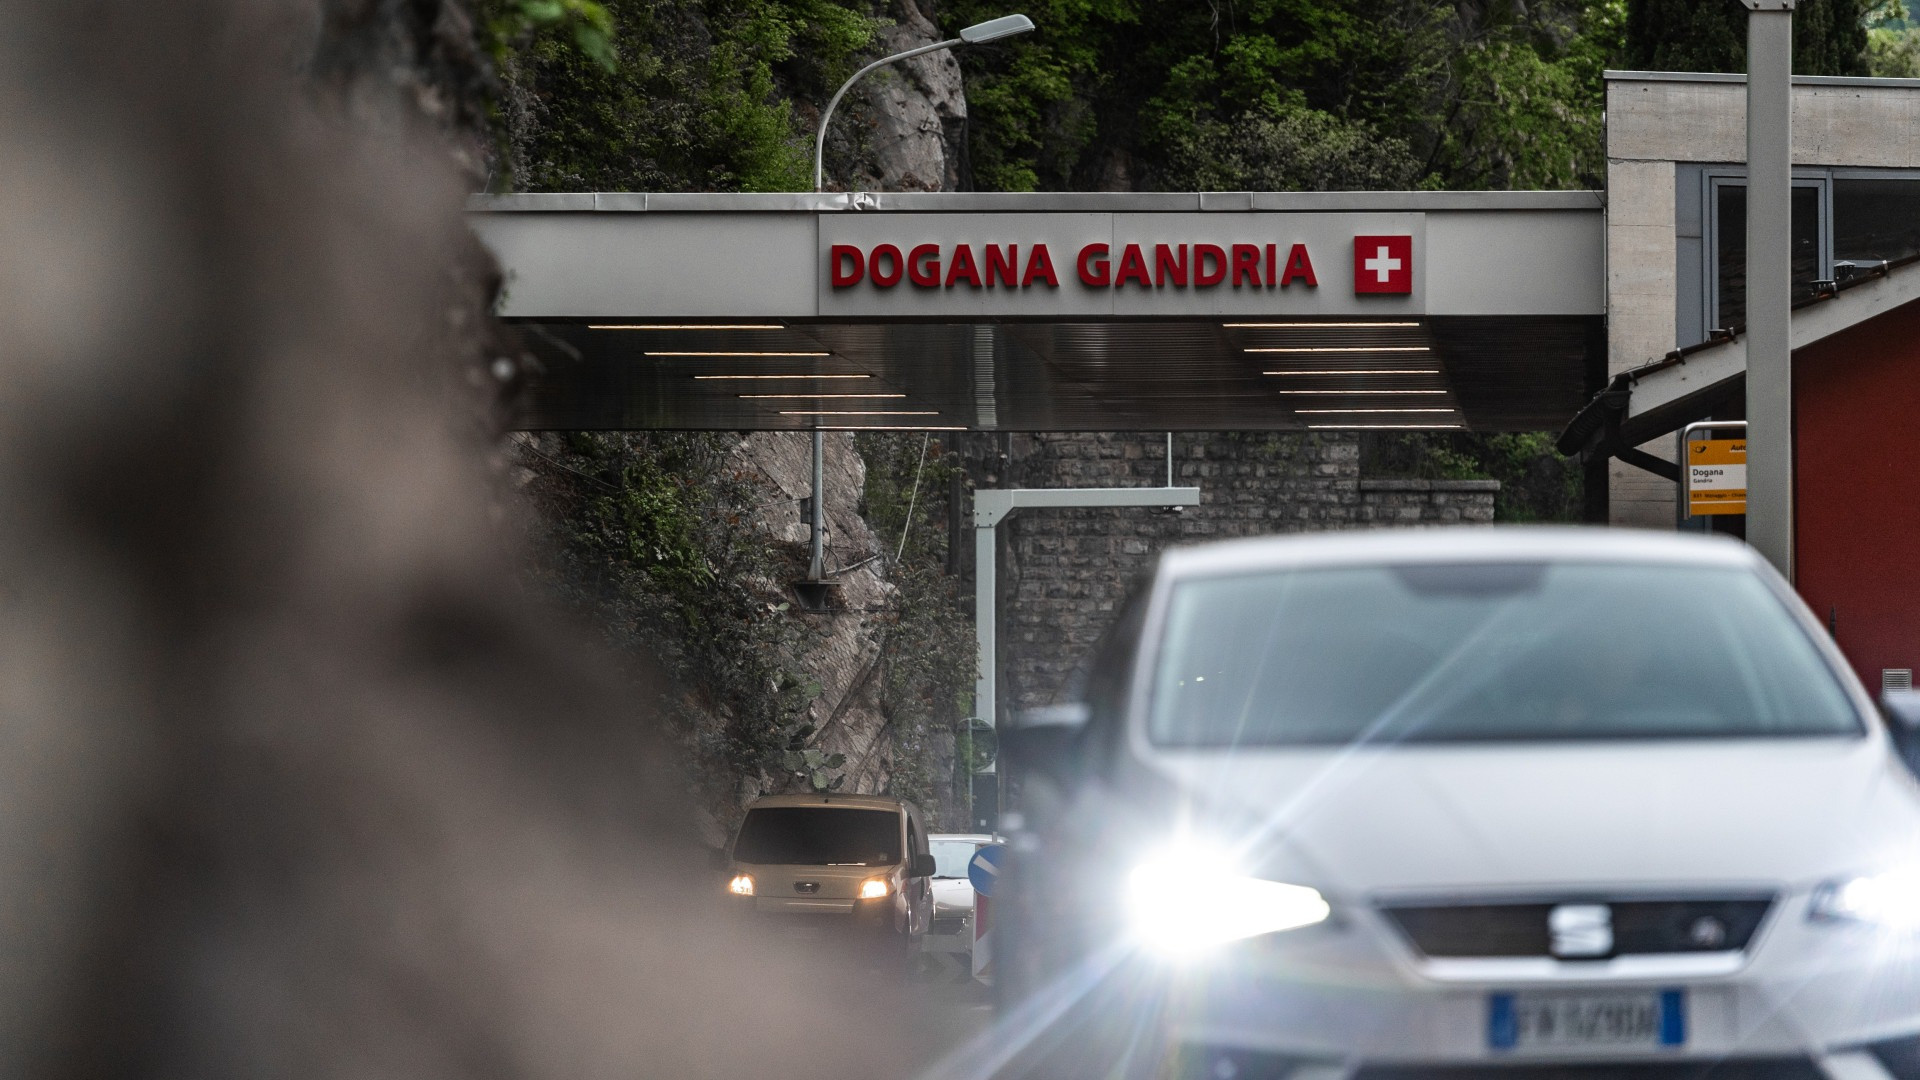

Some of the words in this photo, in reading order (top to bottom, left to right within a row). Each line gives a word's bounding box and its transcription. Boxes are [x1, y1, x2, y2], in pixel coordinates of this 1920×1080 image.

[832, 243, 1059, 288] DOGANA
[1077, 243, 1318, 287] GANDRIA
[1692, 468, 1724, 477] Dogana
